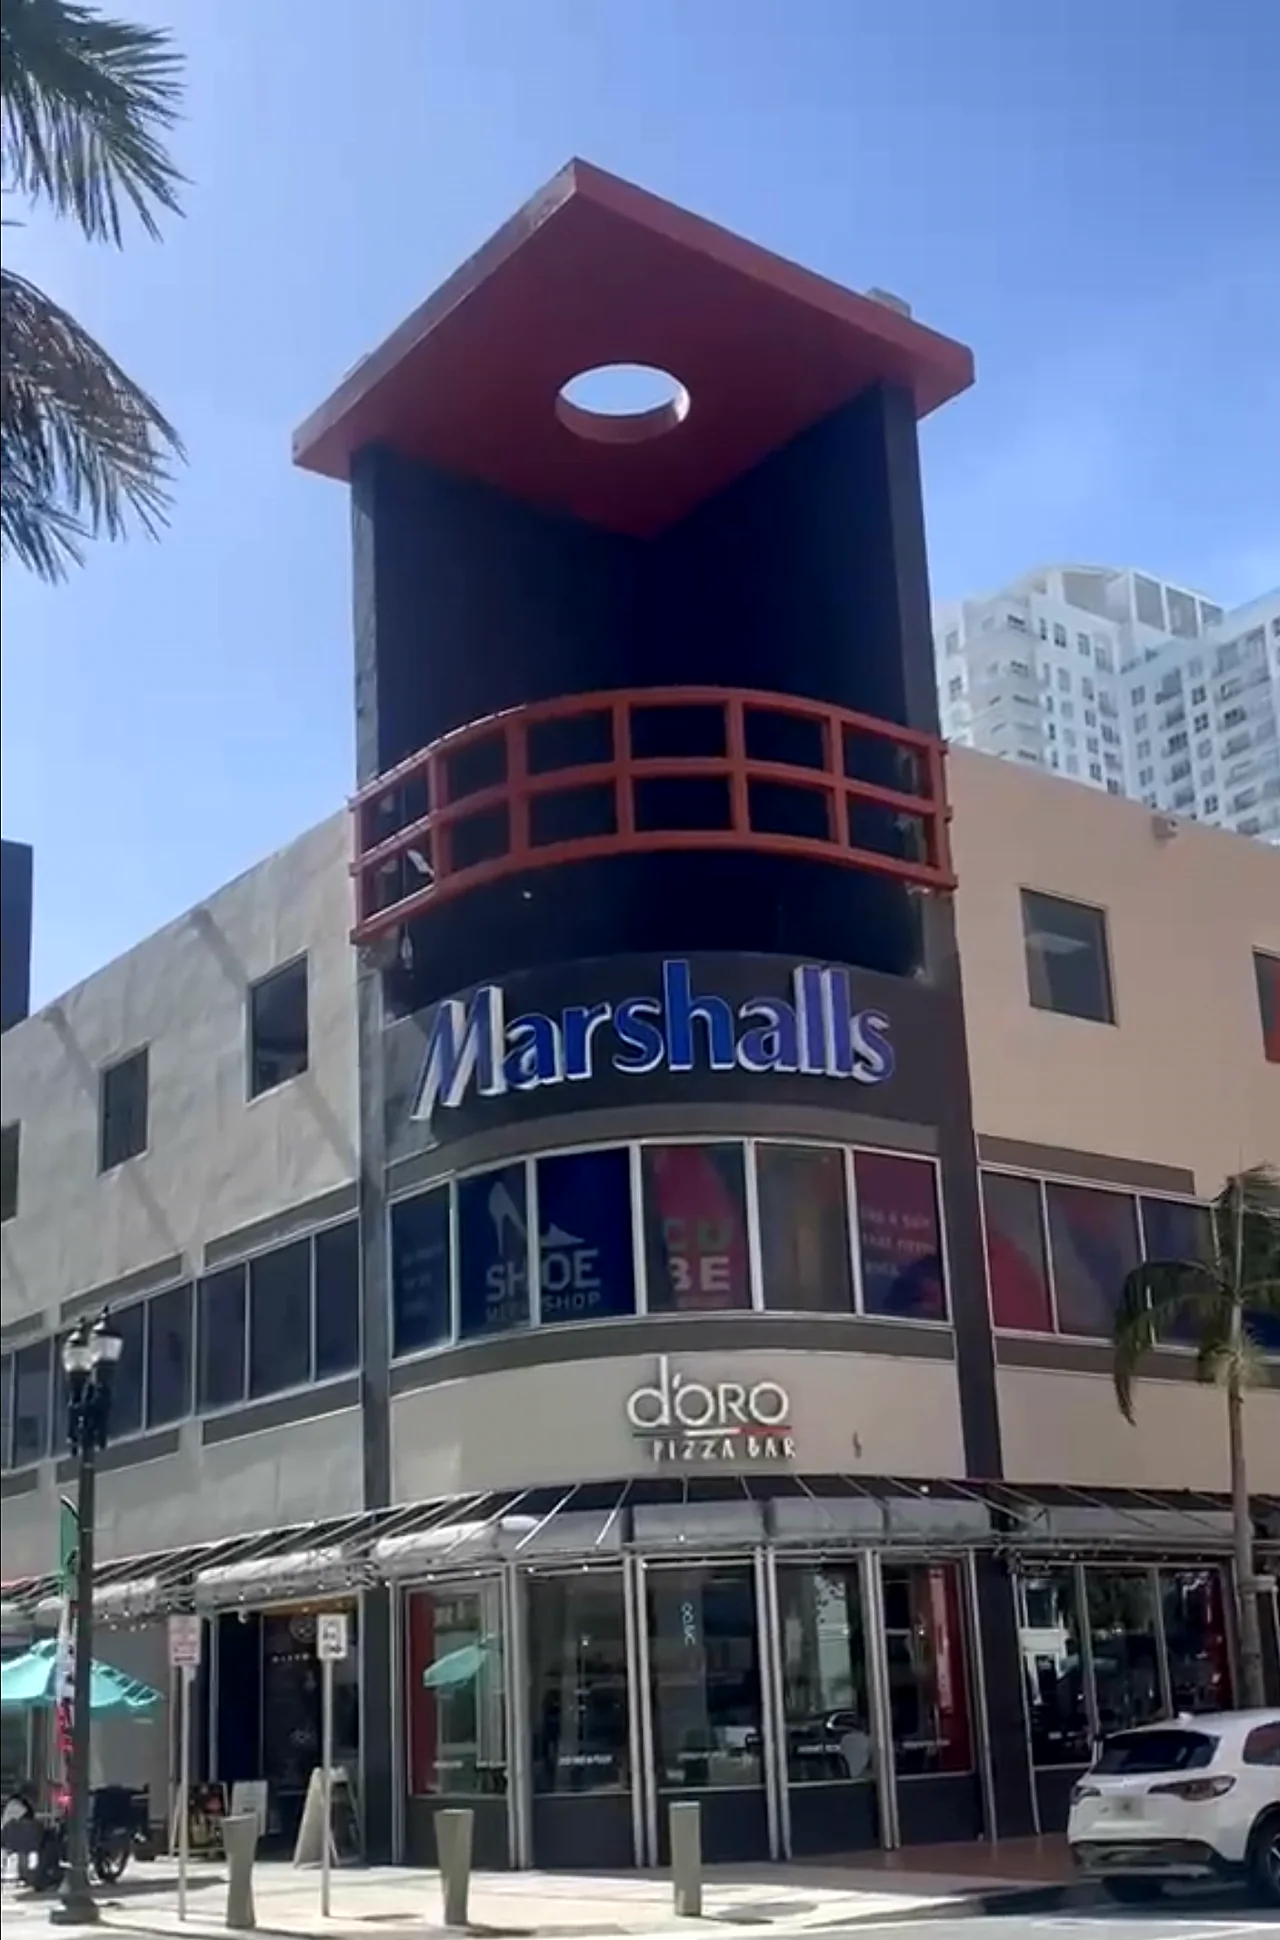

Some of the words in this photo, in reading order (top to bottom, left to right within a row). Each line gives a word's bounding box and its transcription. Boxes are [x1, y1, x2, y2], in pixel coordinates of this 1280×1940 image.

[409, 960, 895, 1121] Marshalls
[485, 1248, 600, 1303] SHOE
[653, 1437, 735, 1462] PIZZA
[748, 1436, 796, 1460] BAR
